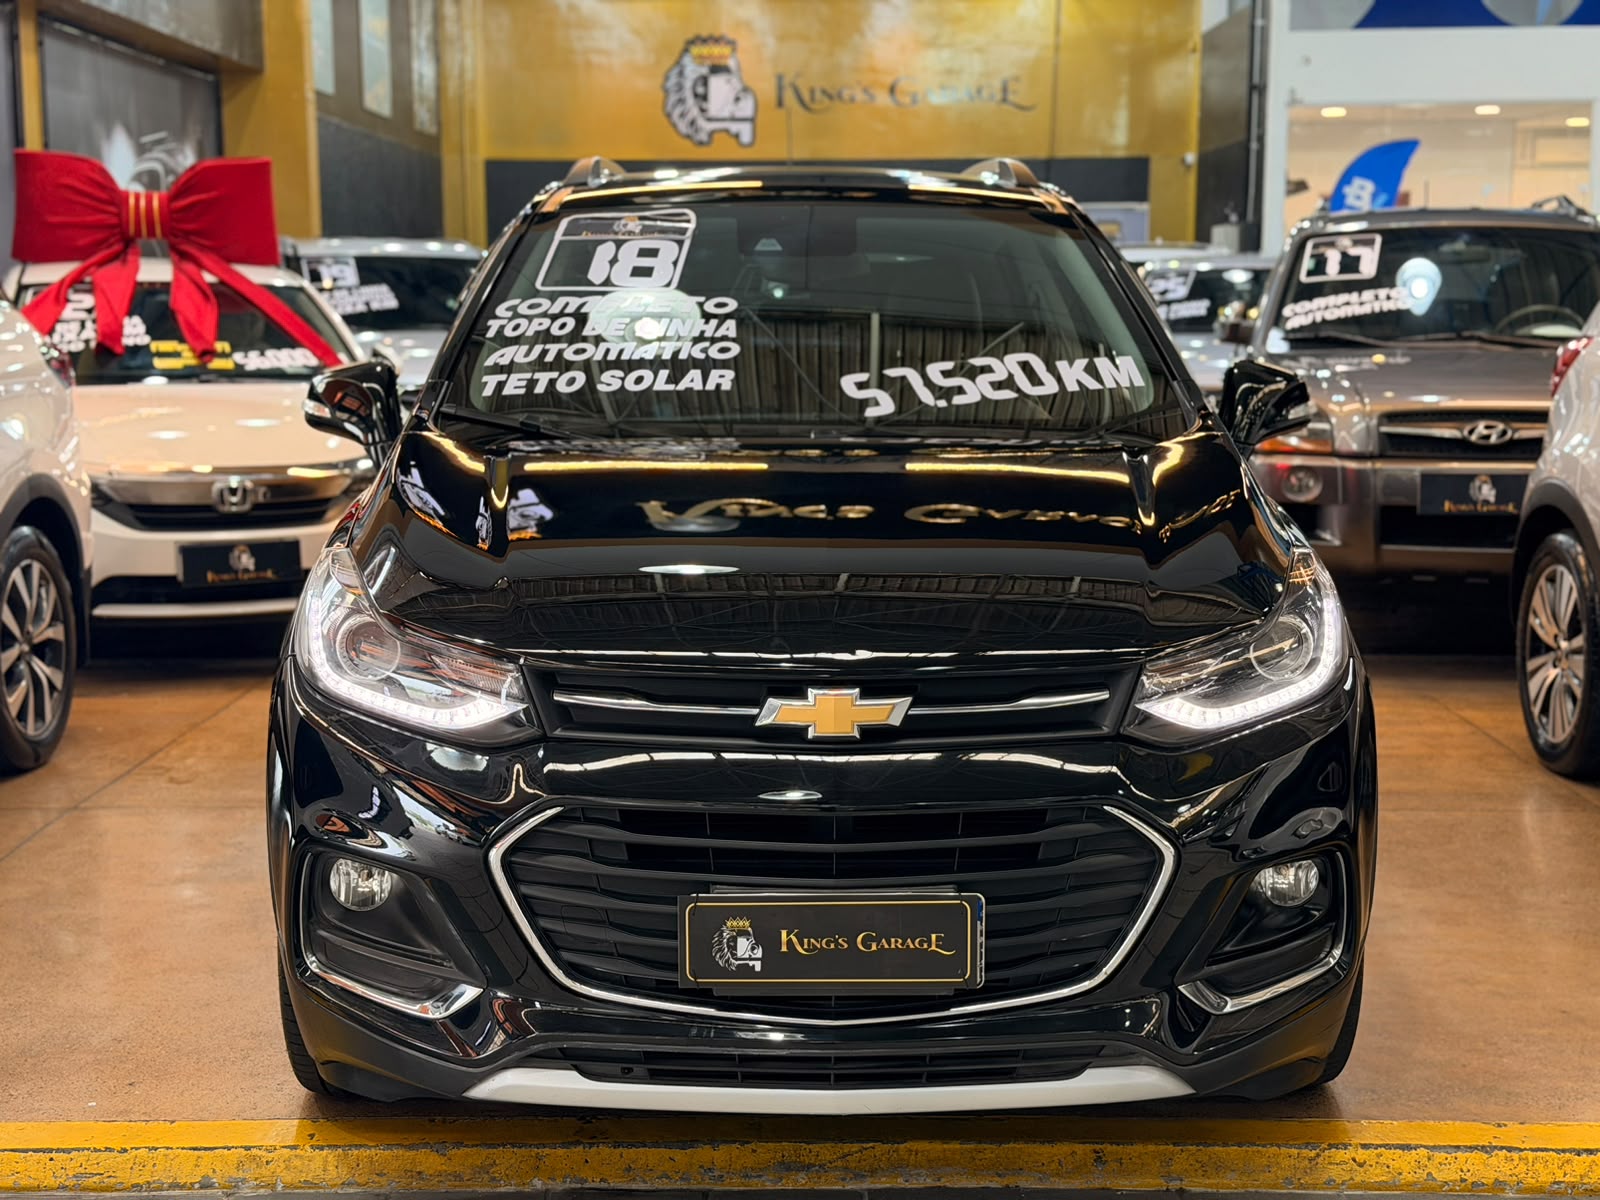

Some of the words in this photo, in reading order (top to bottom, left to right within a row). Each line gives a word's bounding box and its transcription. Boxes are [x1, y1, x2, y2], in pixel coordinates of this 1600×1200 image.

[586, 239, 680, 287] 18
[1282, 286, 1409, 318] COMPLETO
[485, 316, 576, 338] TOPO
[583, 317, 630, 337] DE
[634, 317, 738, 338] INHA
[484, 341, 741, 366] AUTOMATICO
[481, 370, 587, 397] TETO
[596, 369, 736, 392] SOLAR
[780, 929, 849, 955] KING'S
[857, 932, 956, 956] GARAGE
